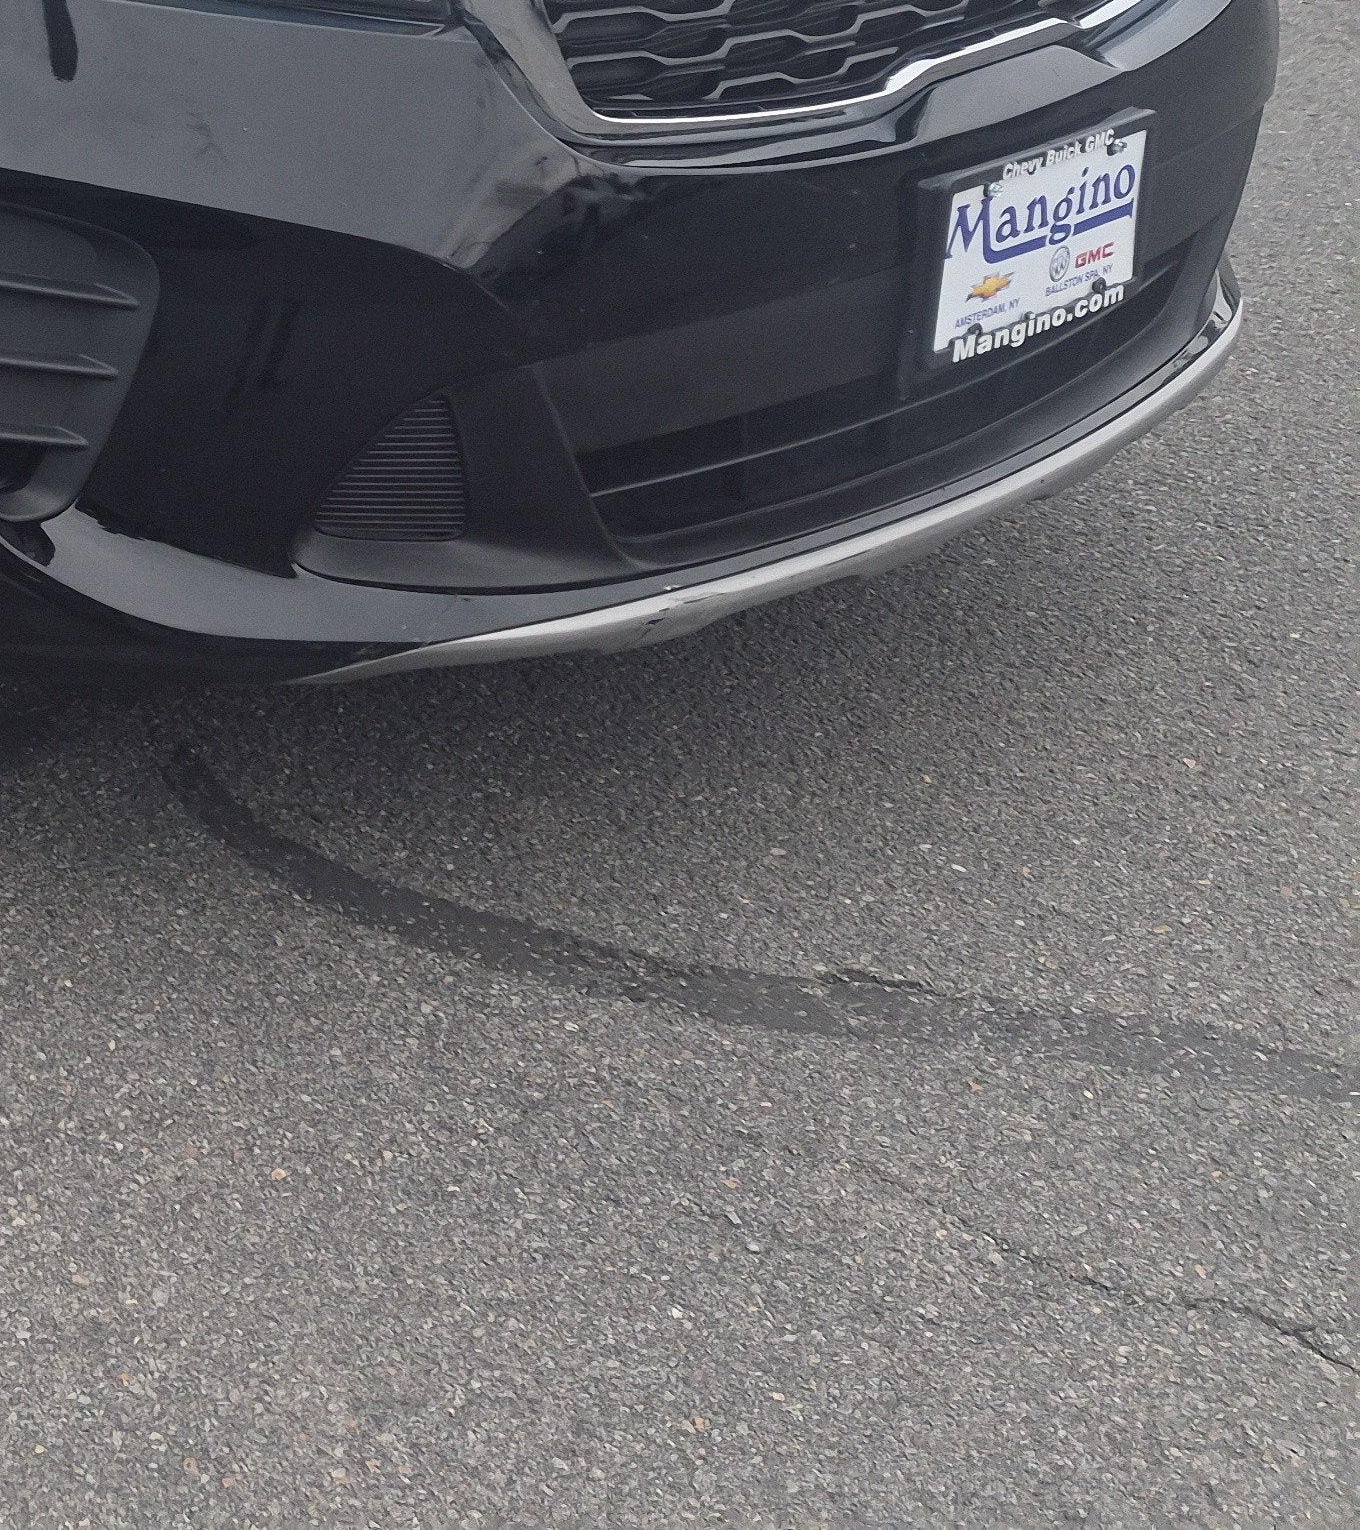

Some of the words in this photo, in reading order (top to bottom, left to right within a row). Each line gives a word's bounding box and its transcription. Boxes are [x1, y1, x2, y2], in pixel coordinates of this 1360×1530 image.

[1002, 157, 1043, 180] Chevy
[1046, 141, 1082, 167] Buick
[1085, 128, 1115, 153] GMC
[945, 164, 1136, 263] Mangino
[1075, 242, 1115, 268] GMC
[1009, 298, 1021, 309] NY
[1045, 277, 1083, 297] BALLSTON
[952, 285, 1125, 363] Mangino.com
